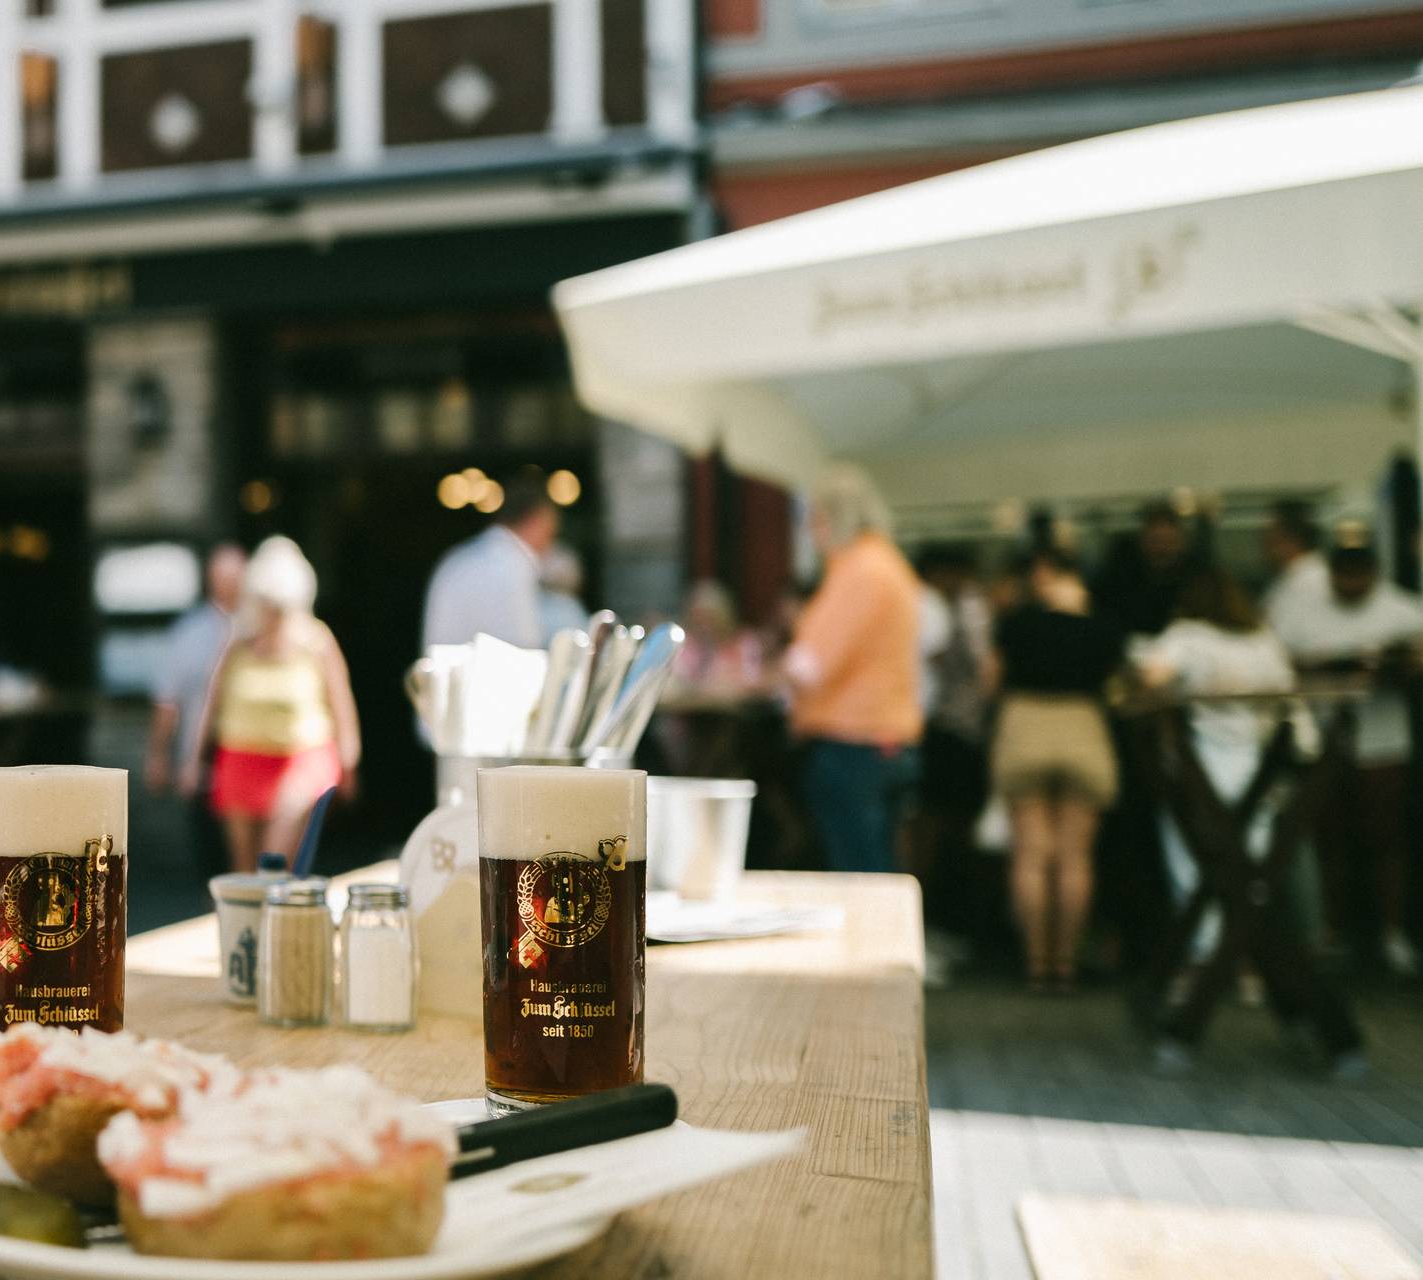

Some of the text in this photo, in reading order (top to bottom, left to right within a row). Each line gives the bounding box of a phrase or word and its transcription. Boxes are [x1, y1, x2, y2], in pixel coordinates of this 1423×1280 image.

[15, 984, 91, 998] Hausbrauerei
[4, 1000, 99, 1025] Zum Schlüssel
[520, 995, 616, 1019] Zum Schlüssel
[542, 1024, 594, 1038] seit 1850
